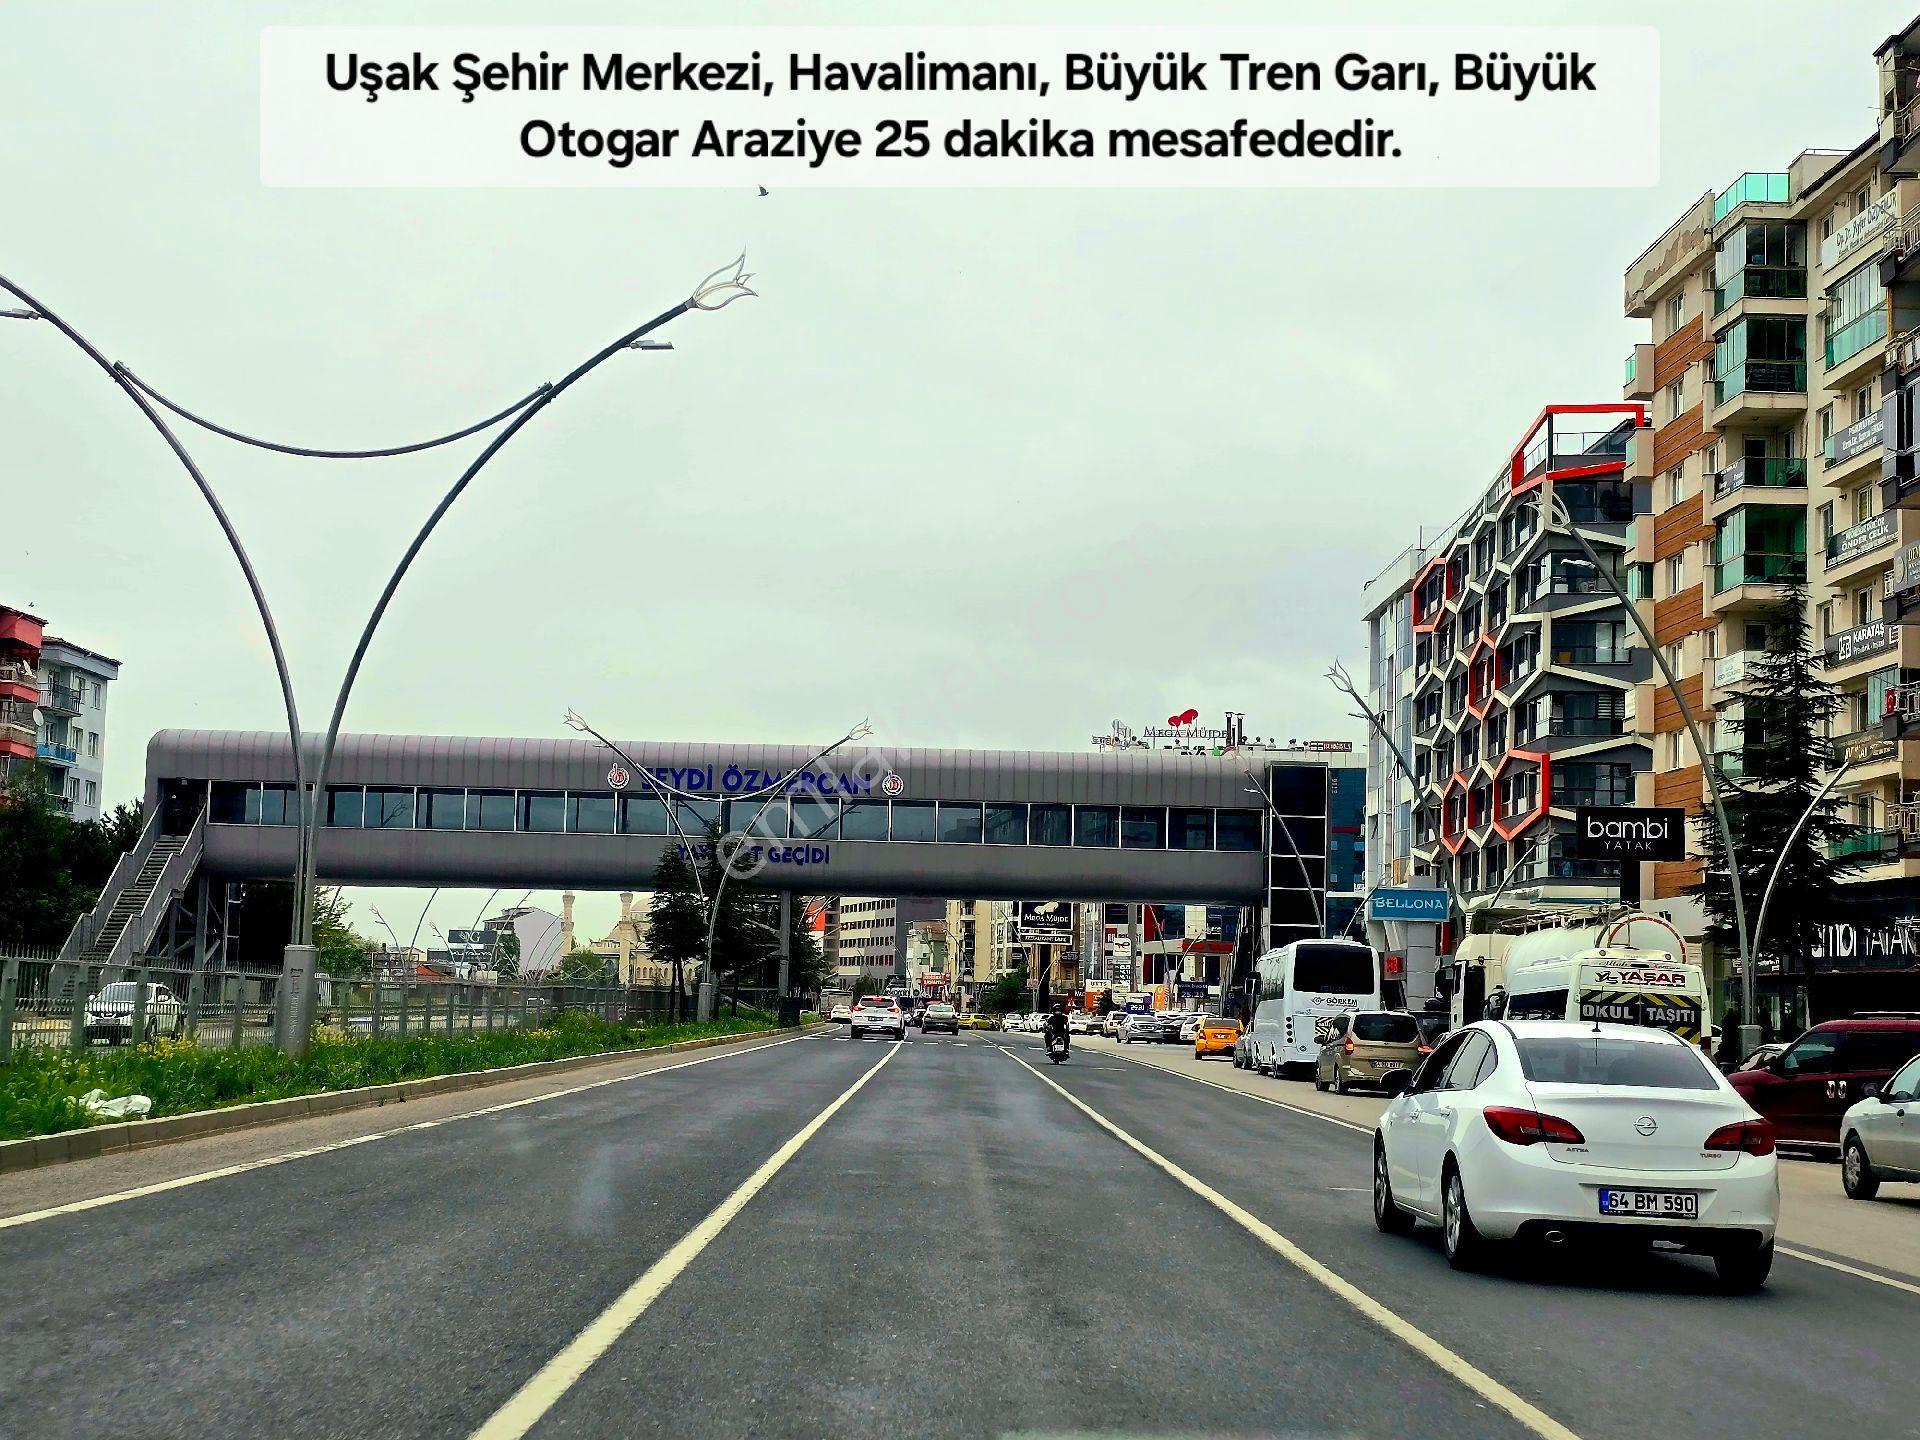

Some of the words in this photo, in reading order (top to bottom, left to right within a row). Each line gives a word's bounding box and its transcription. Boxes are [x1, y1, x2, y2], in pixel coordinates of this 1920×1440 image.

[1853, 622, 1885, 644] KARATAŞ
[1143, 726, 1181, 738] MEGA
[641, 764, 713, 792] SEYDİ
[722, 764, 871, 796] ÖZMERCAN
[1587, 816, 1668, 839] bambi
[767, 844, 830, 866] GEÇİDİ
[1604, 840, 1652, 851] YATAK
[1375, 897, 1444, 910] BELLONA
[1618, 971, 1686, 984] YAŞAR
[1582, 1003, 1634, 1020] OKUL
[1646, 1006, 1695, 1023] TAŞITI
[1609, 1192, 1629, 1209] 64
[1634, 1193, 1658, 1211] BM
[1664, 1195, 1694, 1212] 590
